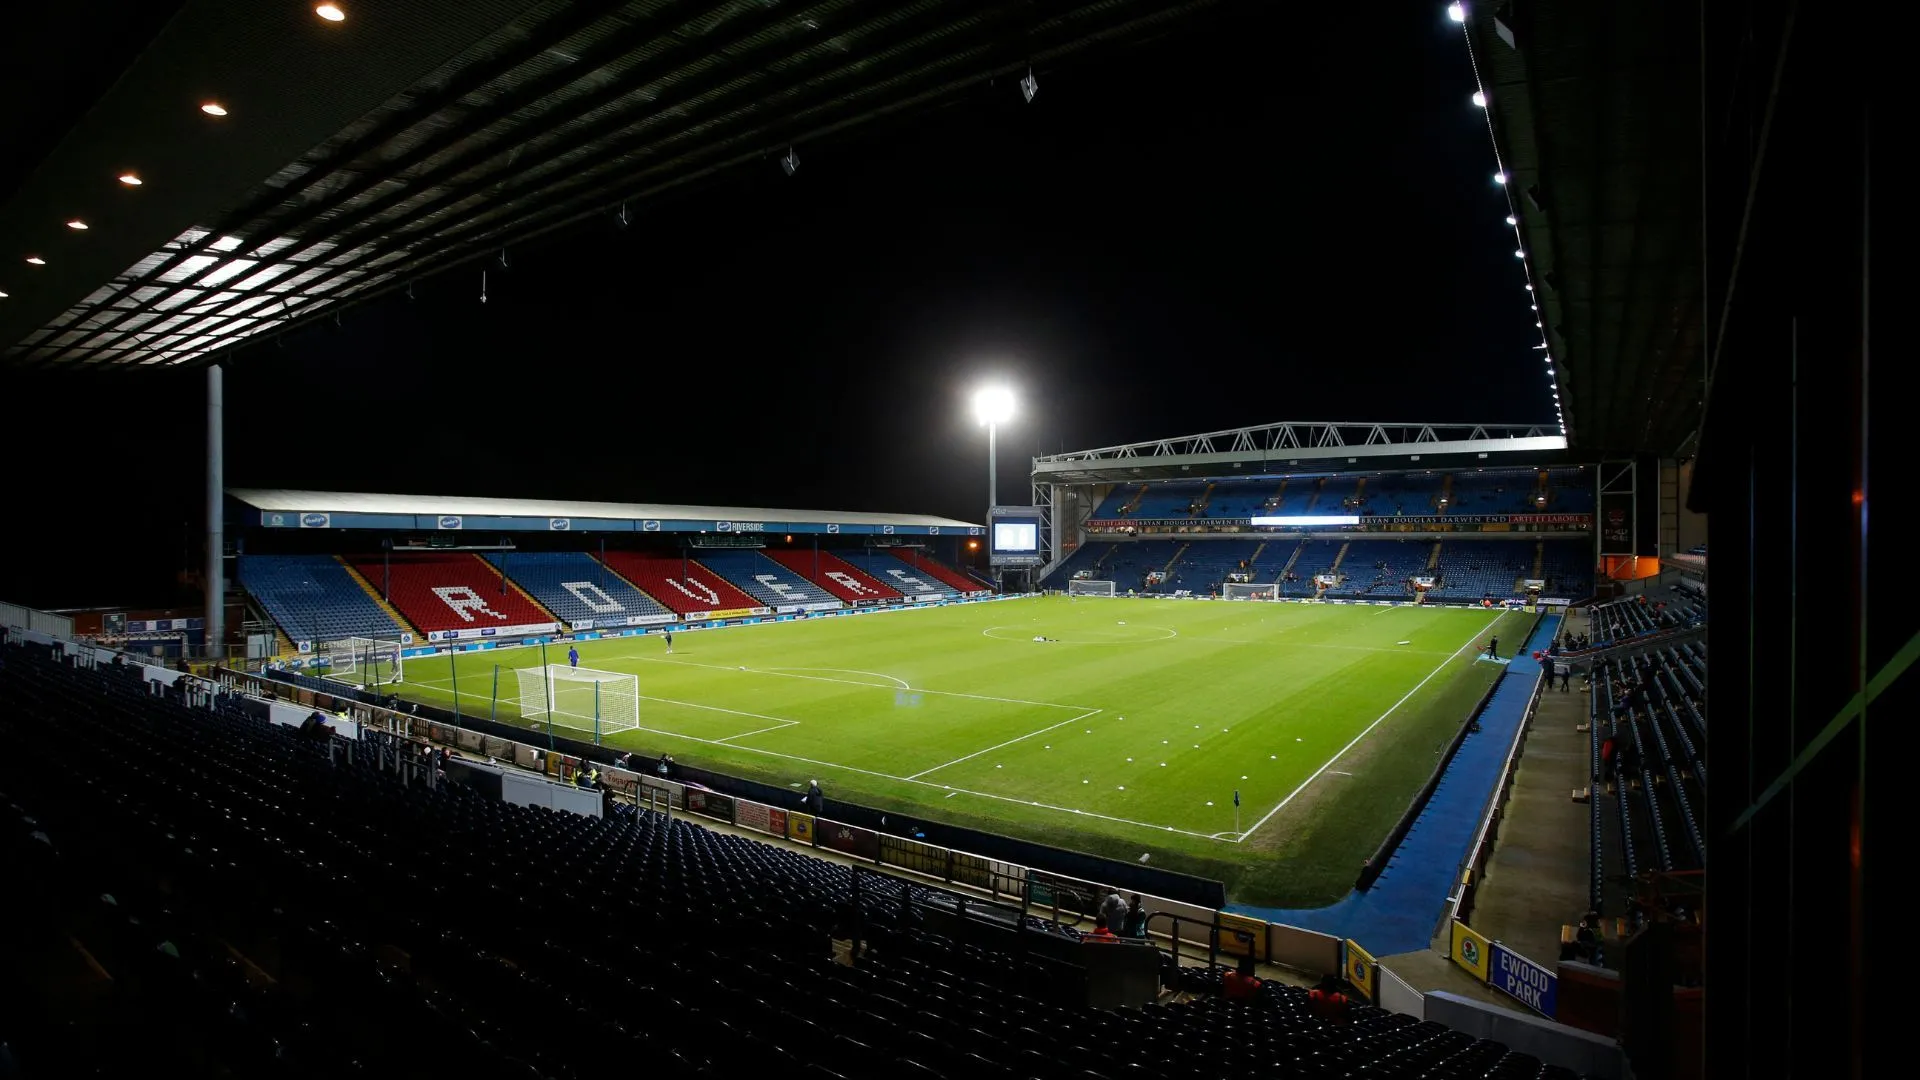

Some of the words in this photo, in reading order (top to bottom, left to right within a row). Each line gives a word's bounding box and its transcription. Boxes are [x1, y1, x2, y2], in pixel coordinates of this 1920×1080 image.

[732, 522, 764, 532] RIVERSIDE
[1502, 952, 1549, 992] EWOOD
[1507, 974, 1543, 1010] PARK
